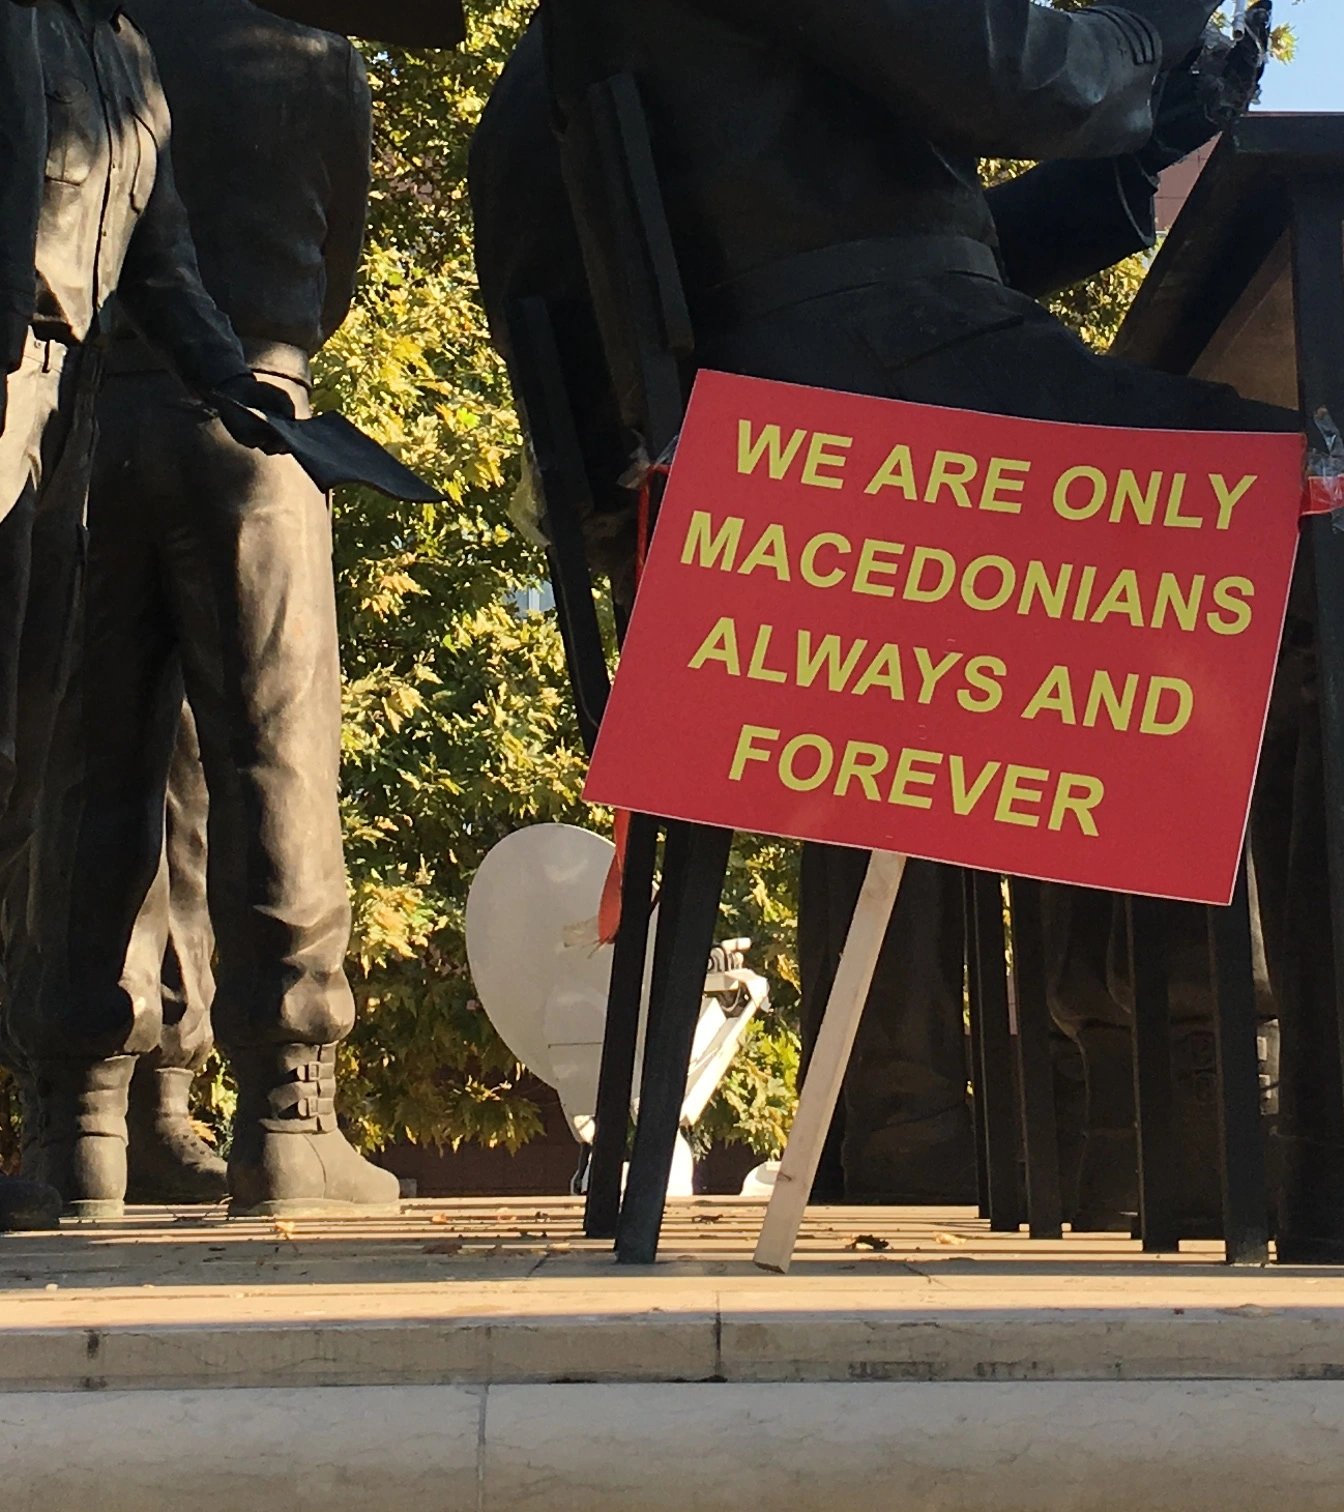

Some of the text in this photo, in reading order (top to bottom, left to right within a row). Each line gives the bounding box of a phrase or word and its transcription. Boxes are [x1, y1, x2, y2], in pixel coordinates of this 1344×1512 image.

[735, 419, 1258, 531] WE ARE ONLY
[679, 510, 1255, 636] MACEDONIANS
[687, 617, 1194, 736] ALWAYS AND
[728, 724, 1105, 837] FOREVER
